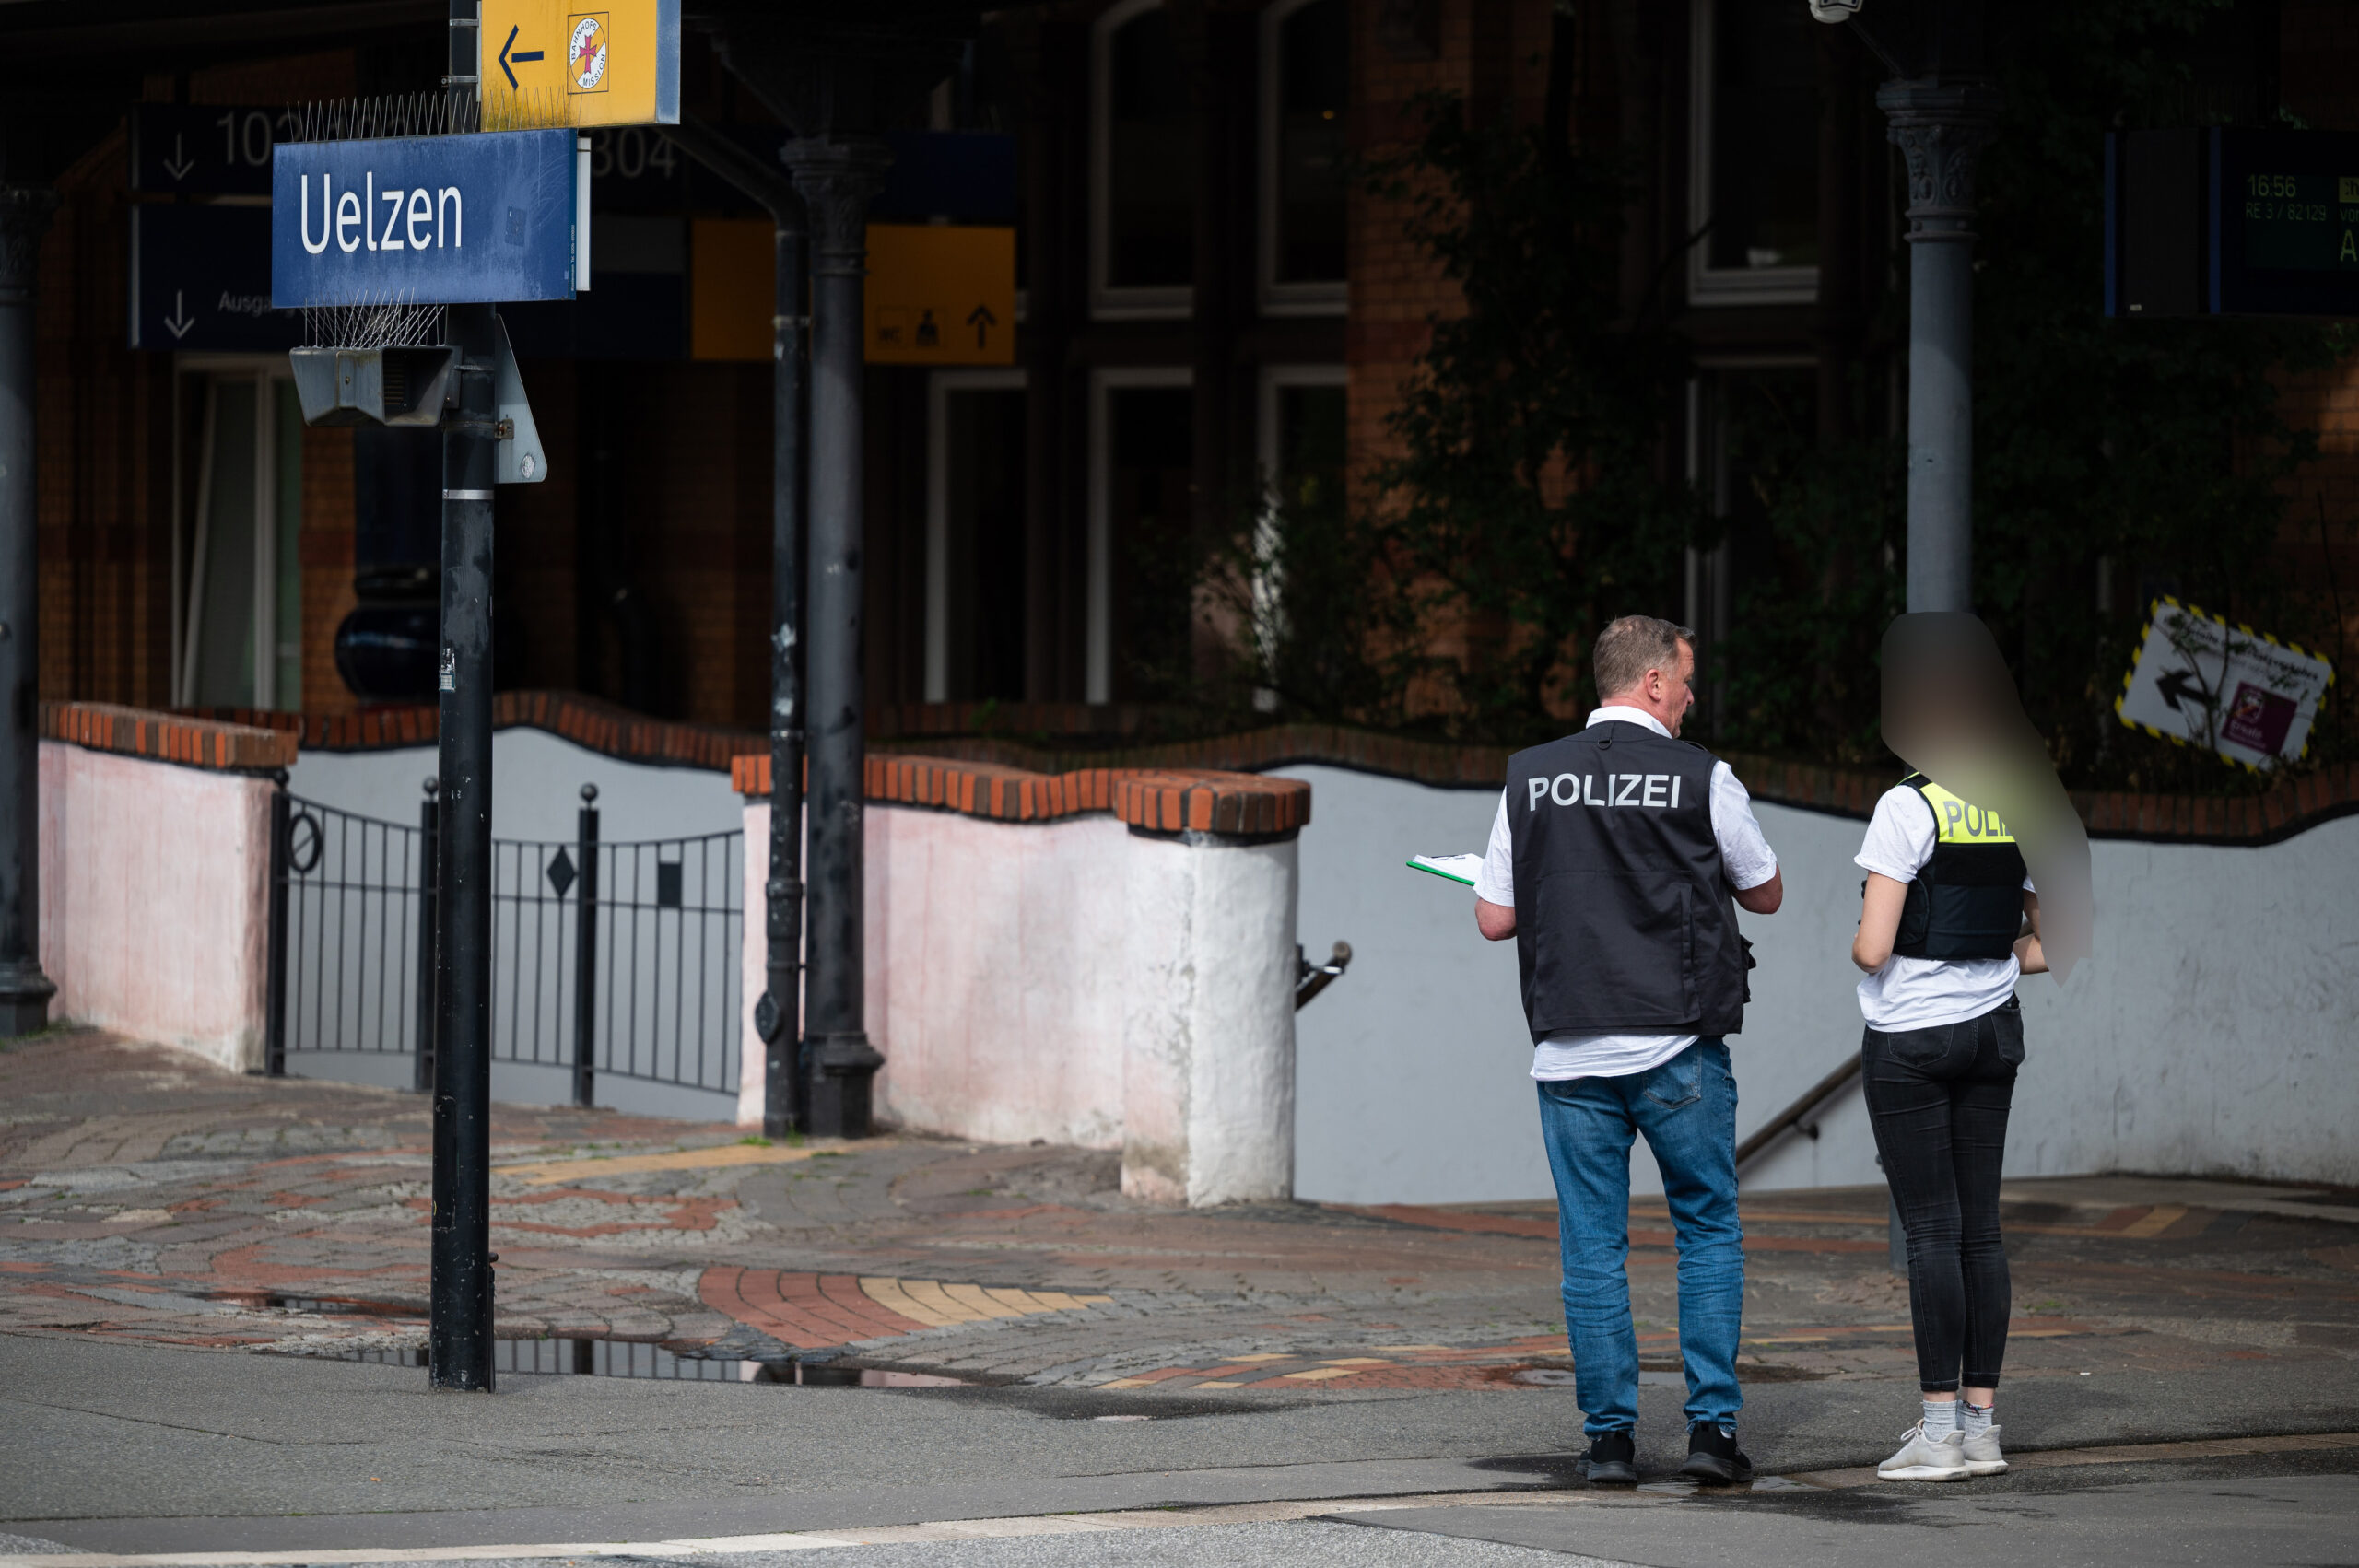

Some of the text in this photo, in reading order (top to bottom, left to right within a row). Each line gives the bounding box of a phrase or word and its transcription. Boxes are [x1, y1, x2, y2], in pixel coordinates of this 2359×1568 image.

[571, 20, 597, 60] BAHNHOFS
[582, 53, 605, 87] MISSION
[2248, 174, 2296, 198] 16:56
[300, 171, 462, 254] Uelzen
[2246, 202, 2327, 221] RE 3 / 82129
[1528, 773, 1681, 812] POLIZEI
[1943, 801, 2013, 837] POLI
